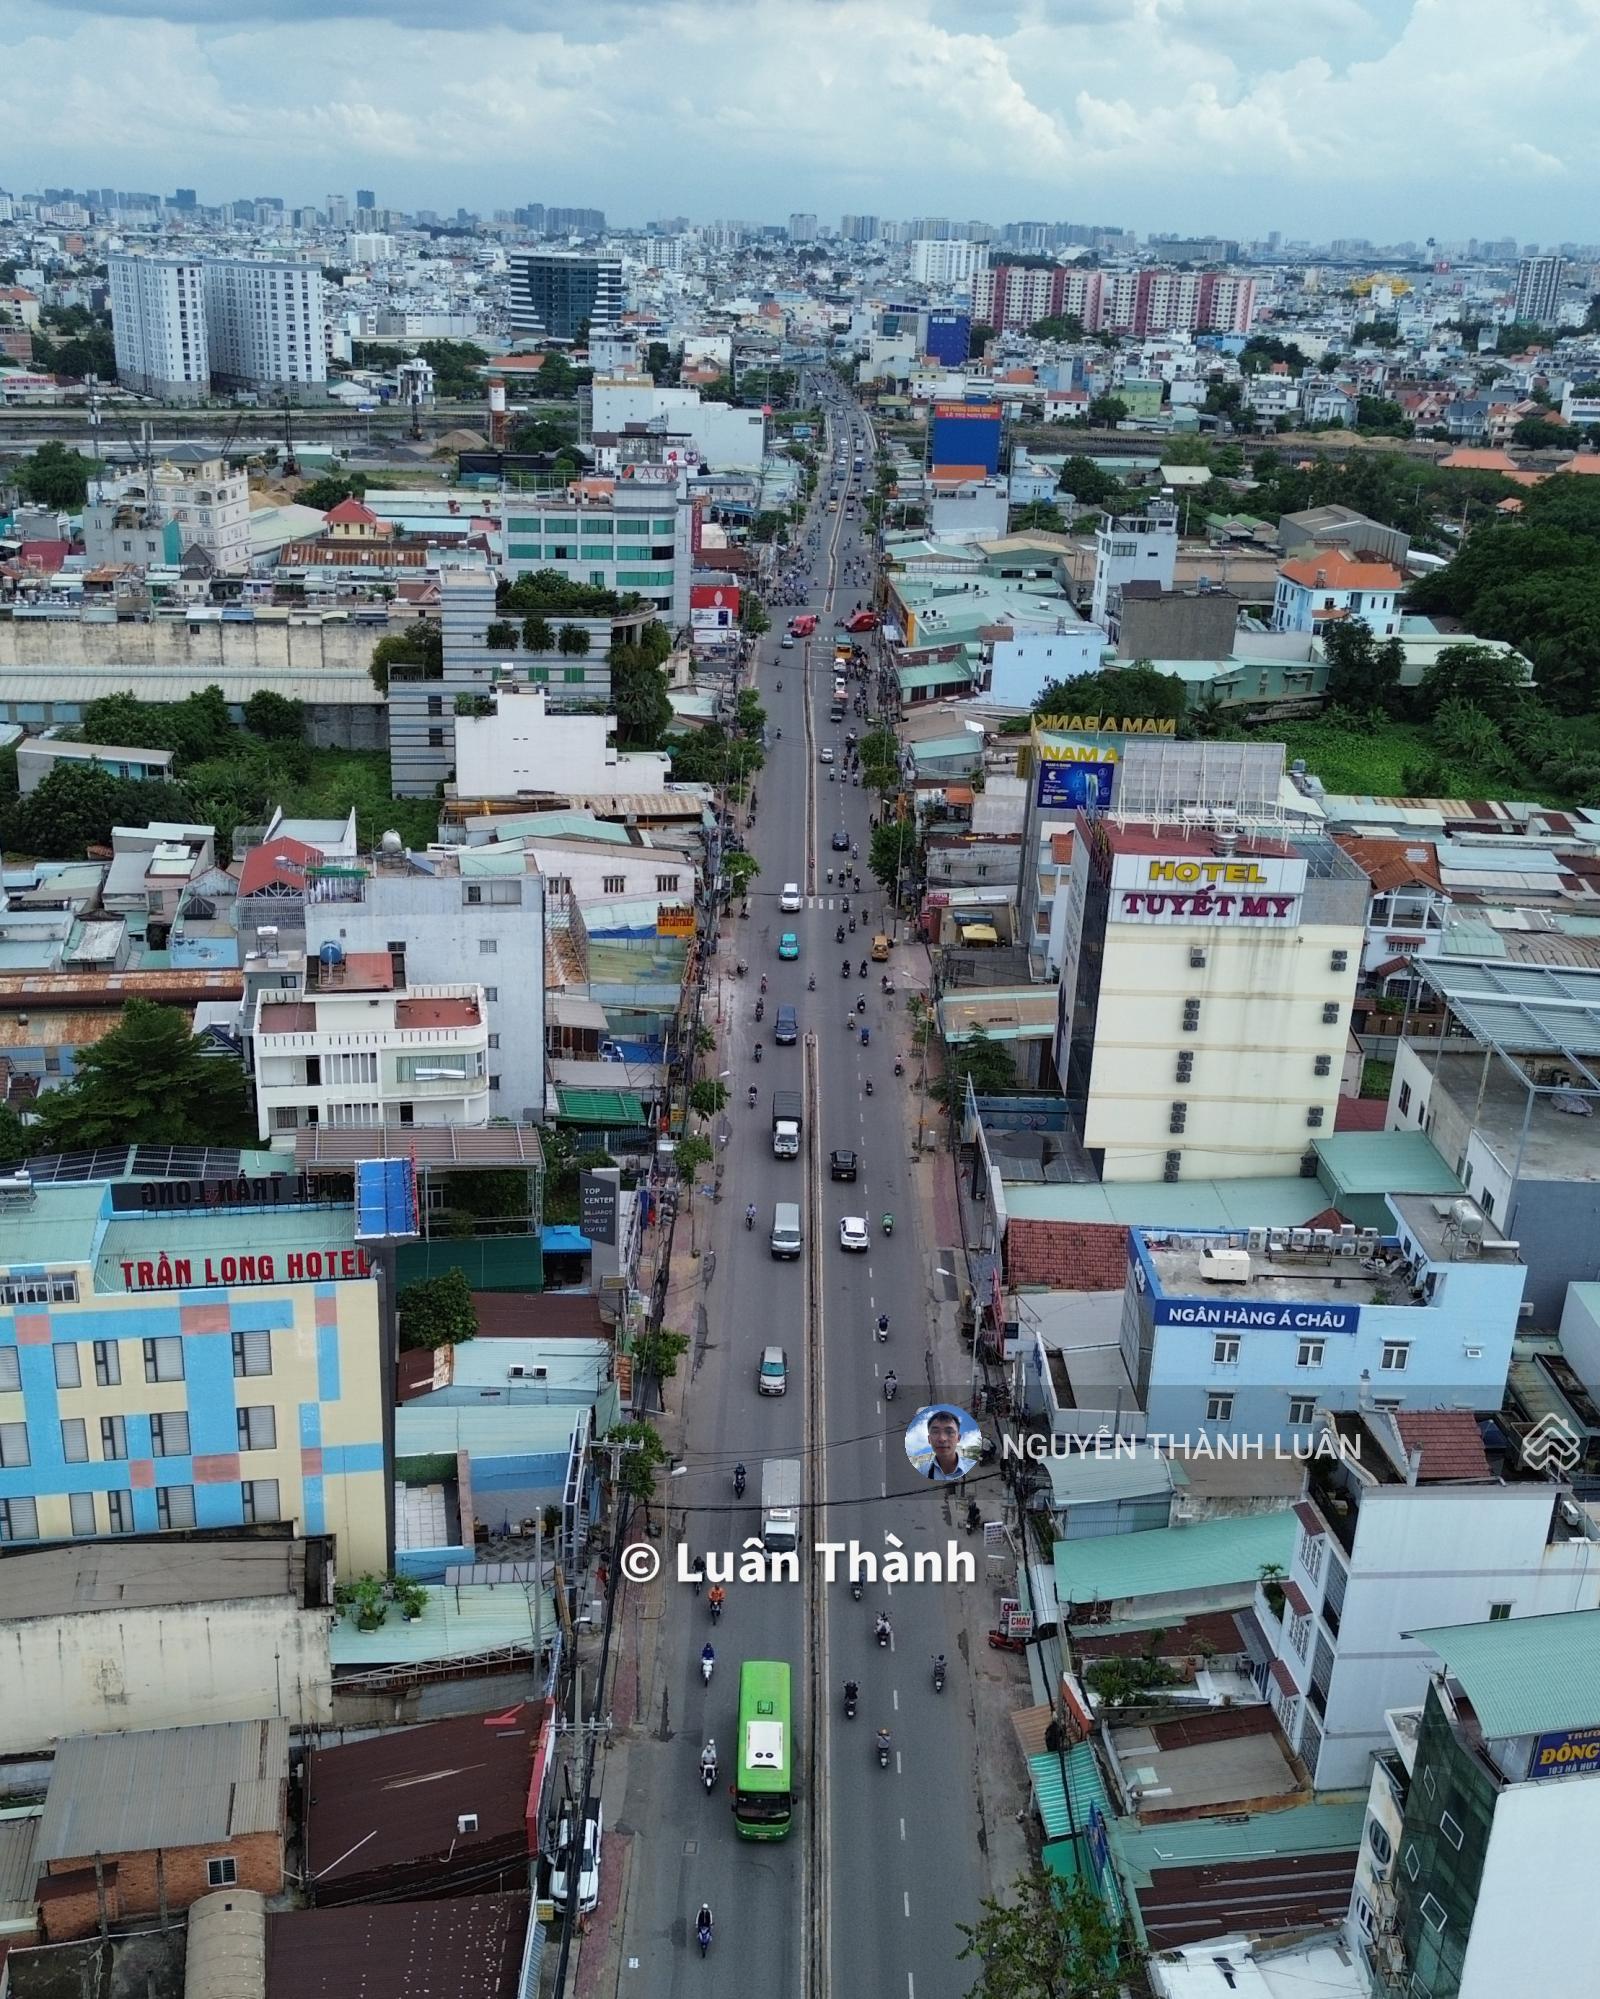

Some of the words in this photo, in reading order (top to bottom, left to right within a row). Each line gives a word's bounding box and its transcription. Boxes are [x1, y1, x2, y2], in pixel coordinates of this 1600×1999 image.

[1042, 745, 1099, 762] NAM
[1102, 747, 1119, 764] A
[1149, 861, 1268, 883] HOTEL
[1122, 884, 1237, 916] TUYẾT
[1240, 895, 1295, 917] MY
[584, 1187, 600, 1195] TOP
[584, 1196, 614, 1204] CENTER
[120, 1250, 192, 1286] TRẦN
[205, 1255, 274, 1283] LONG
[288, 1249, 371, 1278] HOTEL
[1168, 1306, 1220, 1323] NGÂN
[1223, 1308, 1276, 1325] HÀNG
[1278, 1308, 1291, 1325] Á
[1294, 1310, 1346, 1328] CHÂU
[1540, 1742, 1600, 1765] ĐÔNG
[1580, 1761, 1598, 1771] HUY
